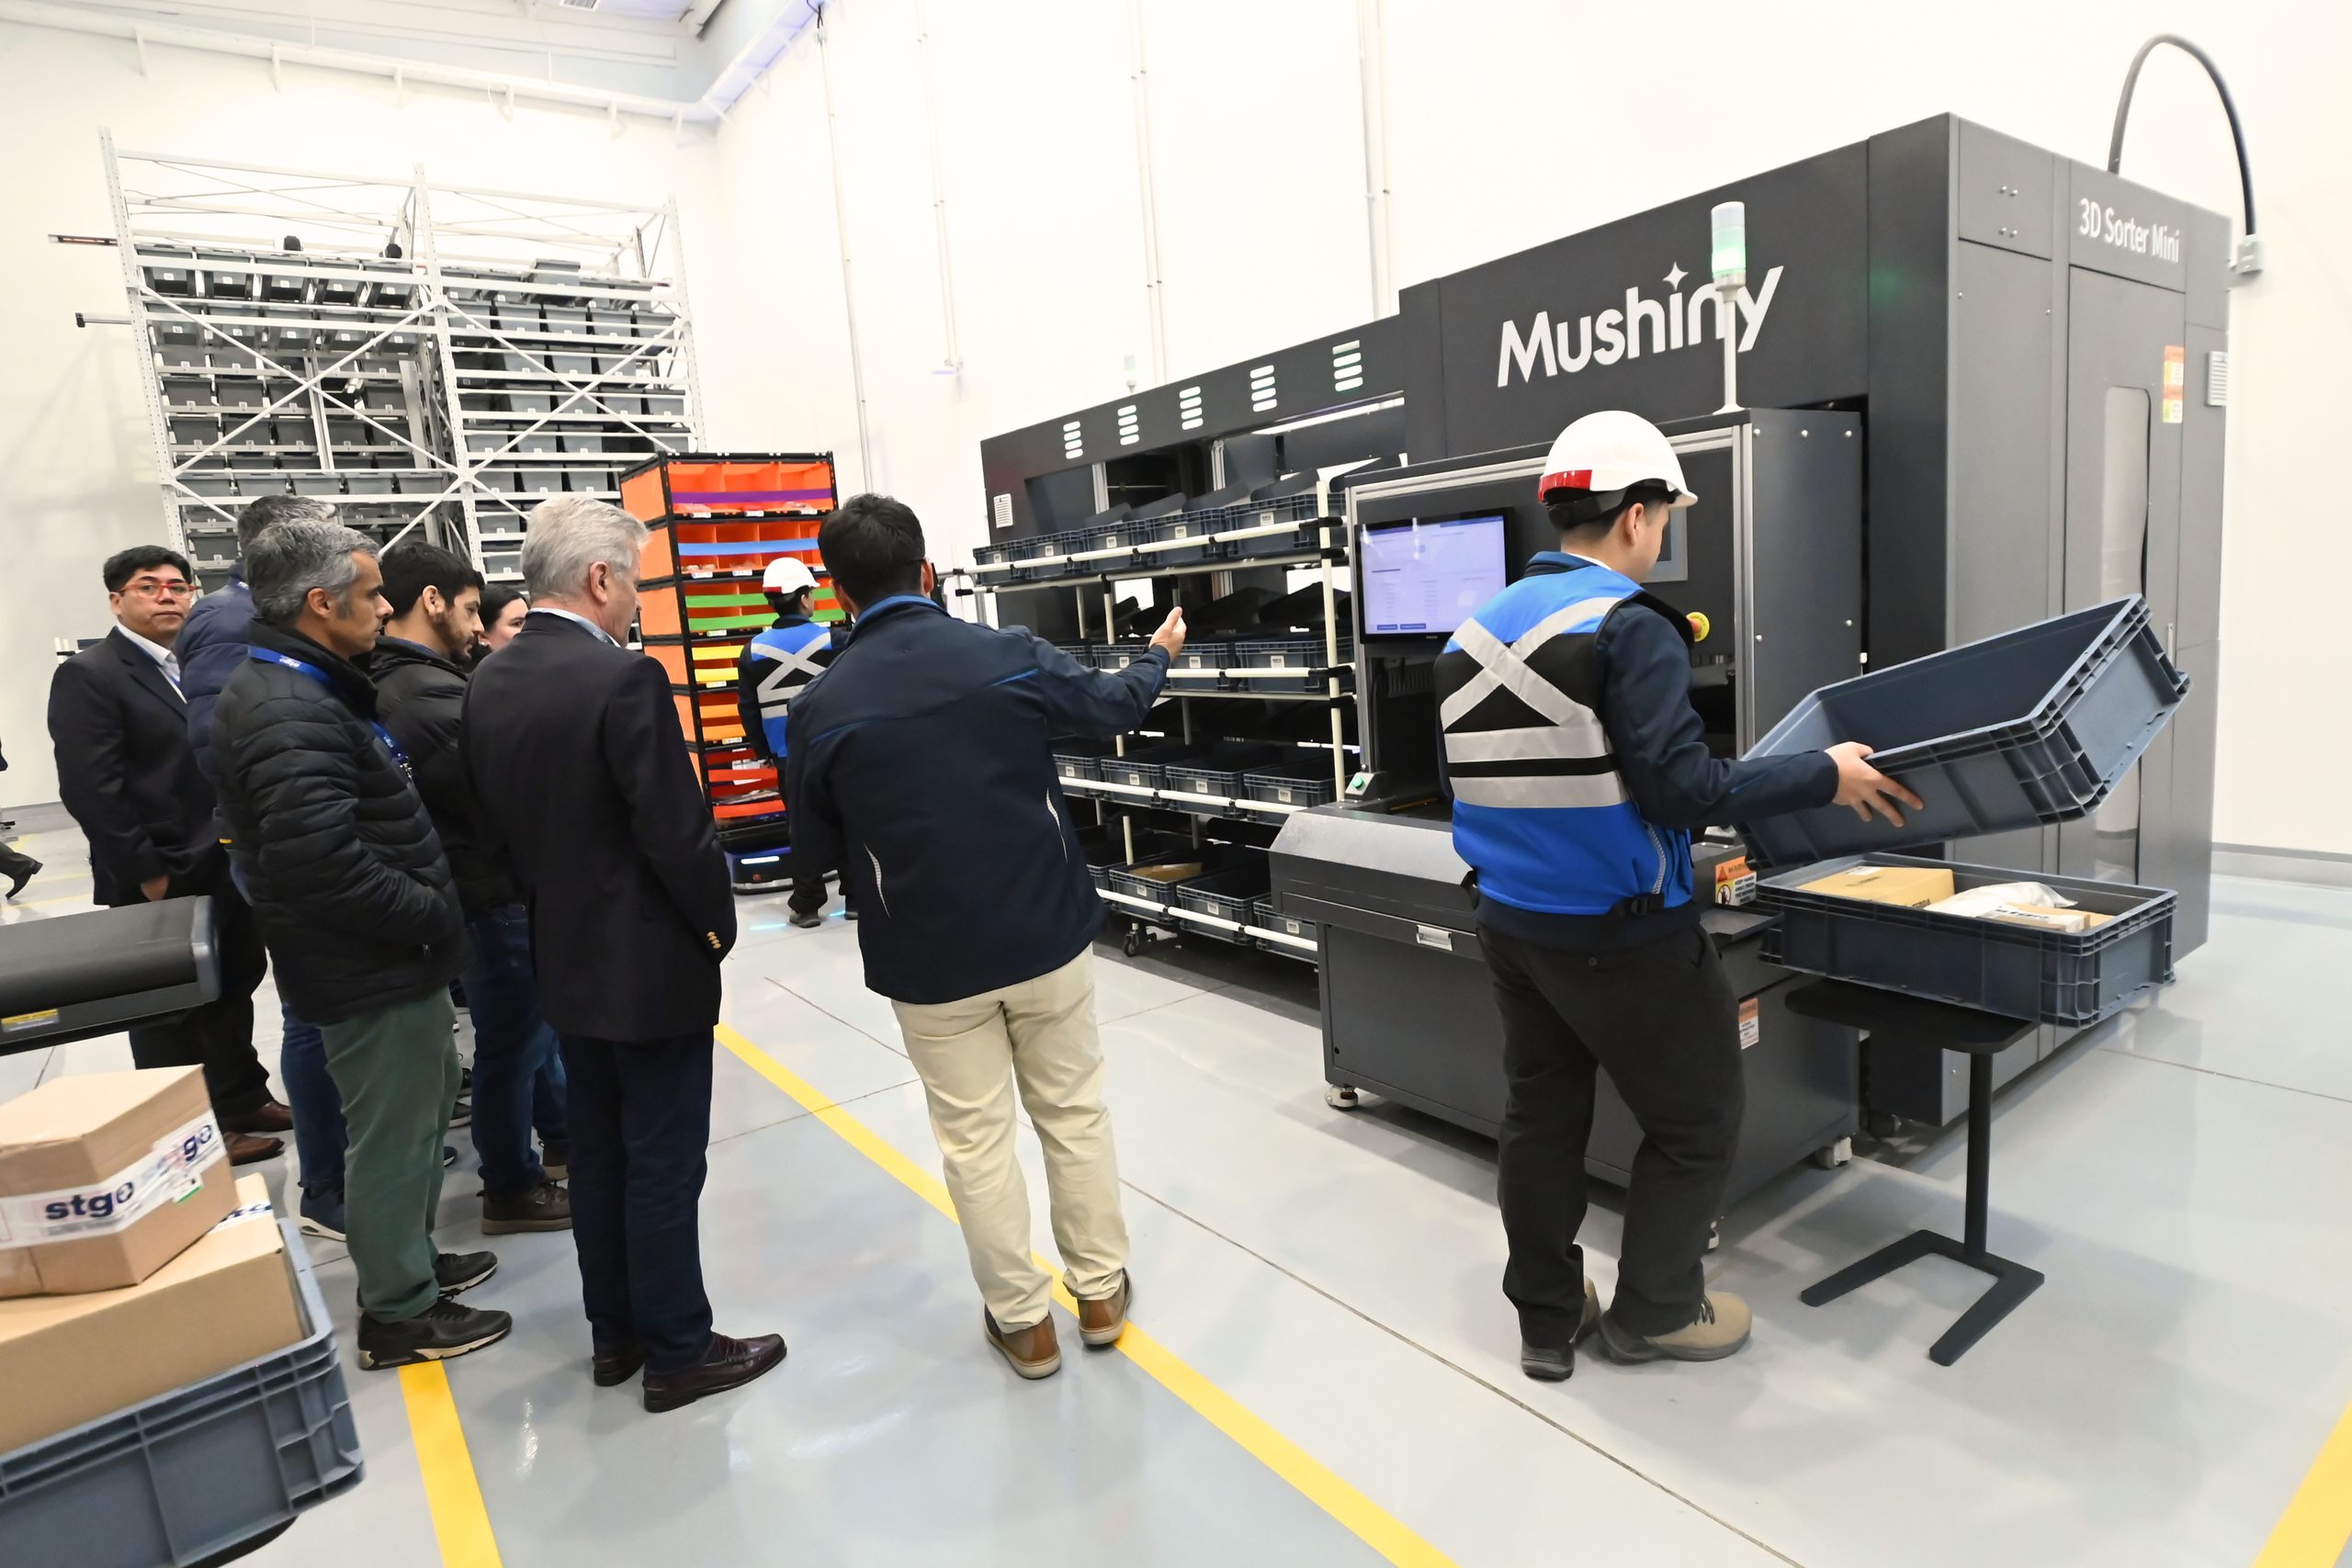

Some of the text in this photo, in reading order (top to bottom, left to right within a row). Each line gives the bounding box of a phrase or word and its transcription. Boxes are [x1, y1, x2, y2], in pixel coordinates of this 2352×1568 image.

[2079, 197, 2179, 264] 3D Sorter Mini
[1498, 264, 1784, 388] Mushiny
[45, 1181, 134, 1220] stgo
